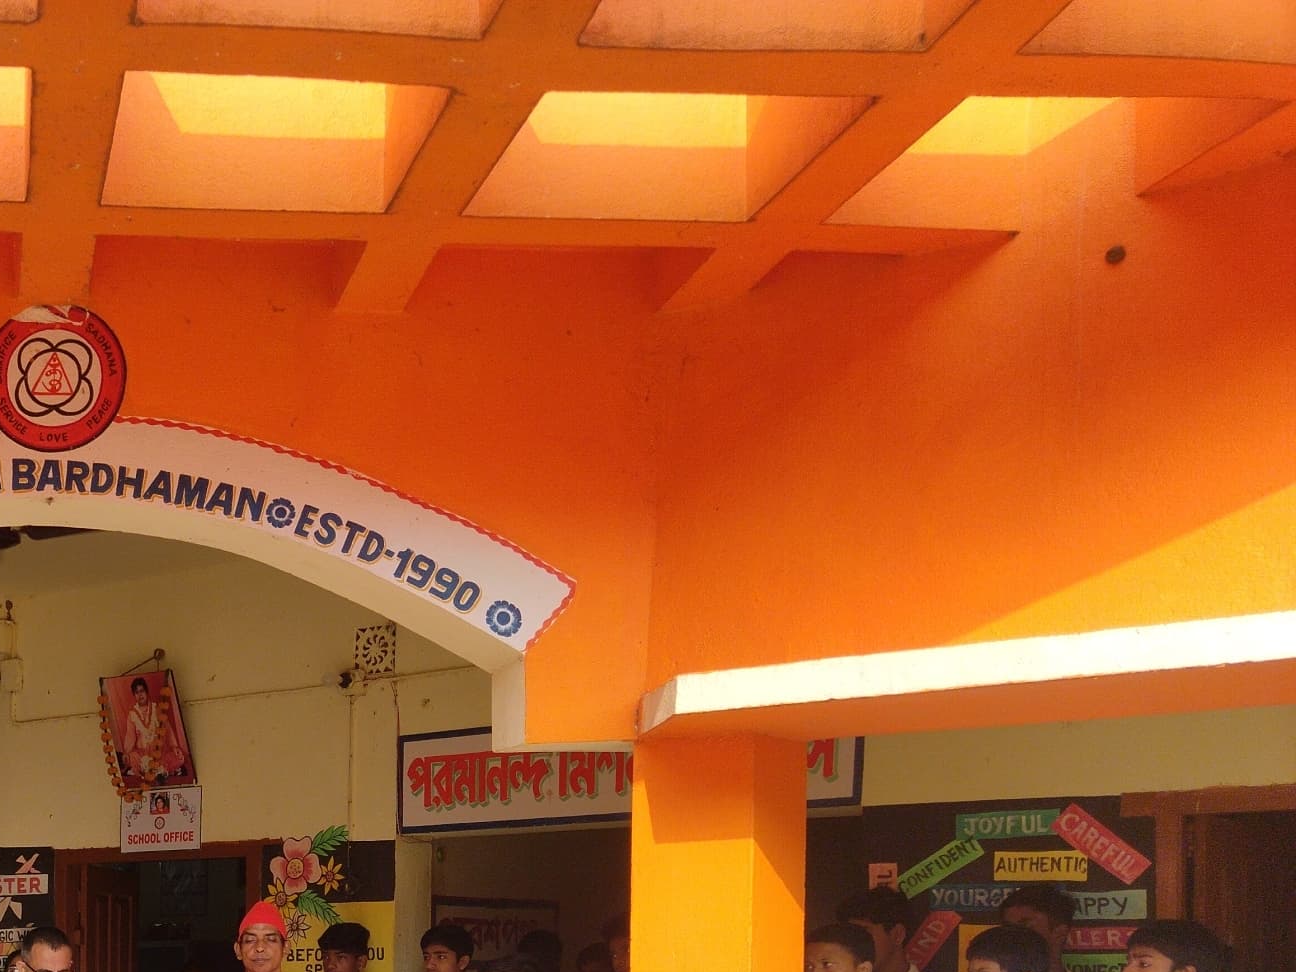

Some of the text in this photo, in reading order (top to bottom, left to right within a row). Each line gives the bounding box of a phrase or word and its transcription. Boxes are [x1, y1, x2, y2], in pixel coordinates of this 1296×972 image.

[86, 323, 117, 377] SADHANA
[86, 397, 113, 430] PEACE
[39, 432, 69, 442] LOVE
[11, 459, 269, 523] BARDHAMAN
[295, 505, 481, 614] ESTD-1990
[127, 830, 194, 845] SCHOOL OFFICE
[963, 815, 1049, 836] JOYFUL
[1060, 813, 1136, 873] CAREFUL
[898, 837, 980, 893] CONFIDENT
[995, 856, 1089, 875] AUTHENTIC
[1073, 897, 1128, 916] APPY
